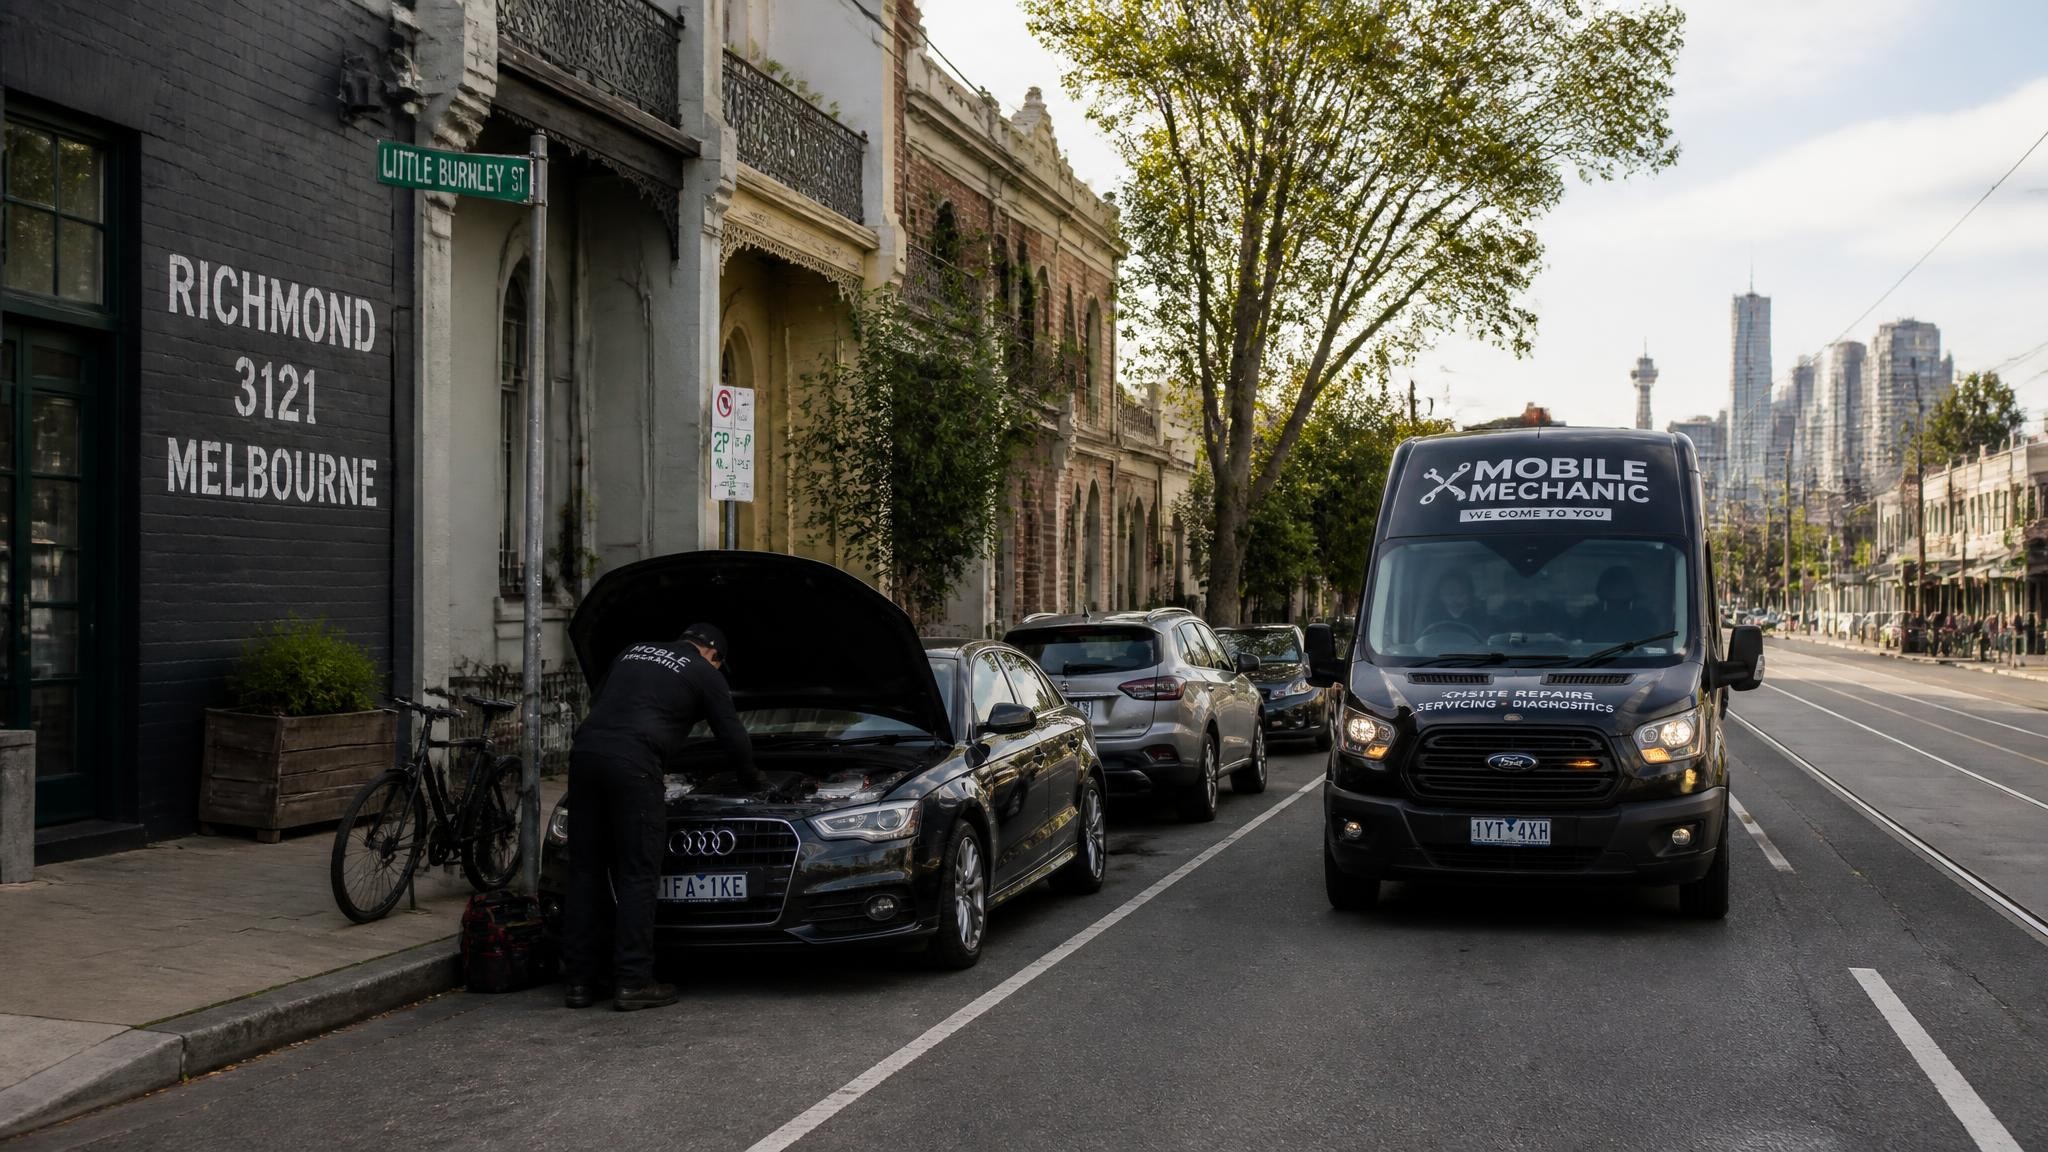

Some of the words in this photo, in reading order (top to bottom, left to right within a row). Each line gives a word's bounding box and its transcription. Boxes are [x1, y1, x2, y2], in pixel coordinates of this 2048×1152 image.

[383, 148, 432, 184] LITTLE
[439, 158, 504, 192] BURNLEY
[511, 166, 525, 193] ST
[168, 253, 376, 353] RICHMOND
[234, 356, 317, 425] 3121
[713, 431, 729, 453] 2P
[167, 437, 377, 507] MELBOURNE
[1474, 457, 1648, 482] MOBILE
[1468, 481, 1649, 503] MECHANIC
[1469, 511, 1492, 519] WE
[1498, 510, 1541, 518] COME
[1547, 509, 1566, 518] TO
[1573, 510, 1604, 518] YOU
[1416, 700, 1496, 712] SERVICING
[1515, 690, 1594, 700] REPAIRS
